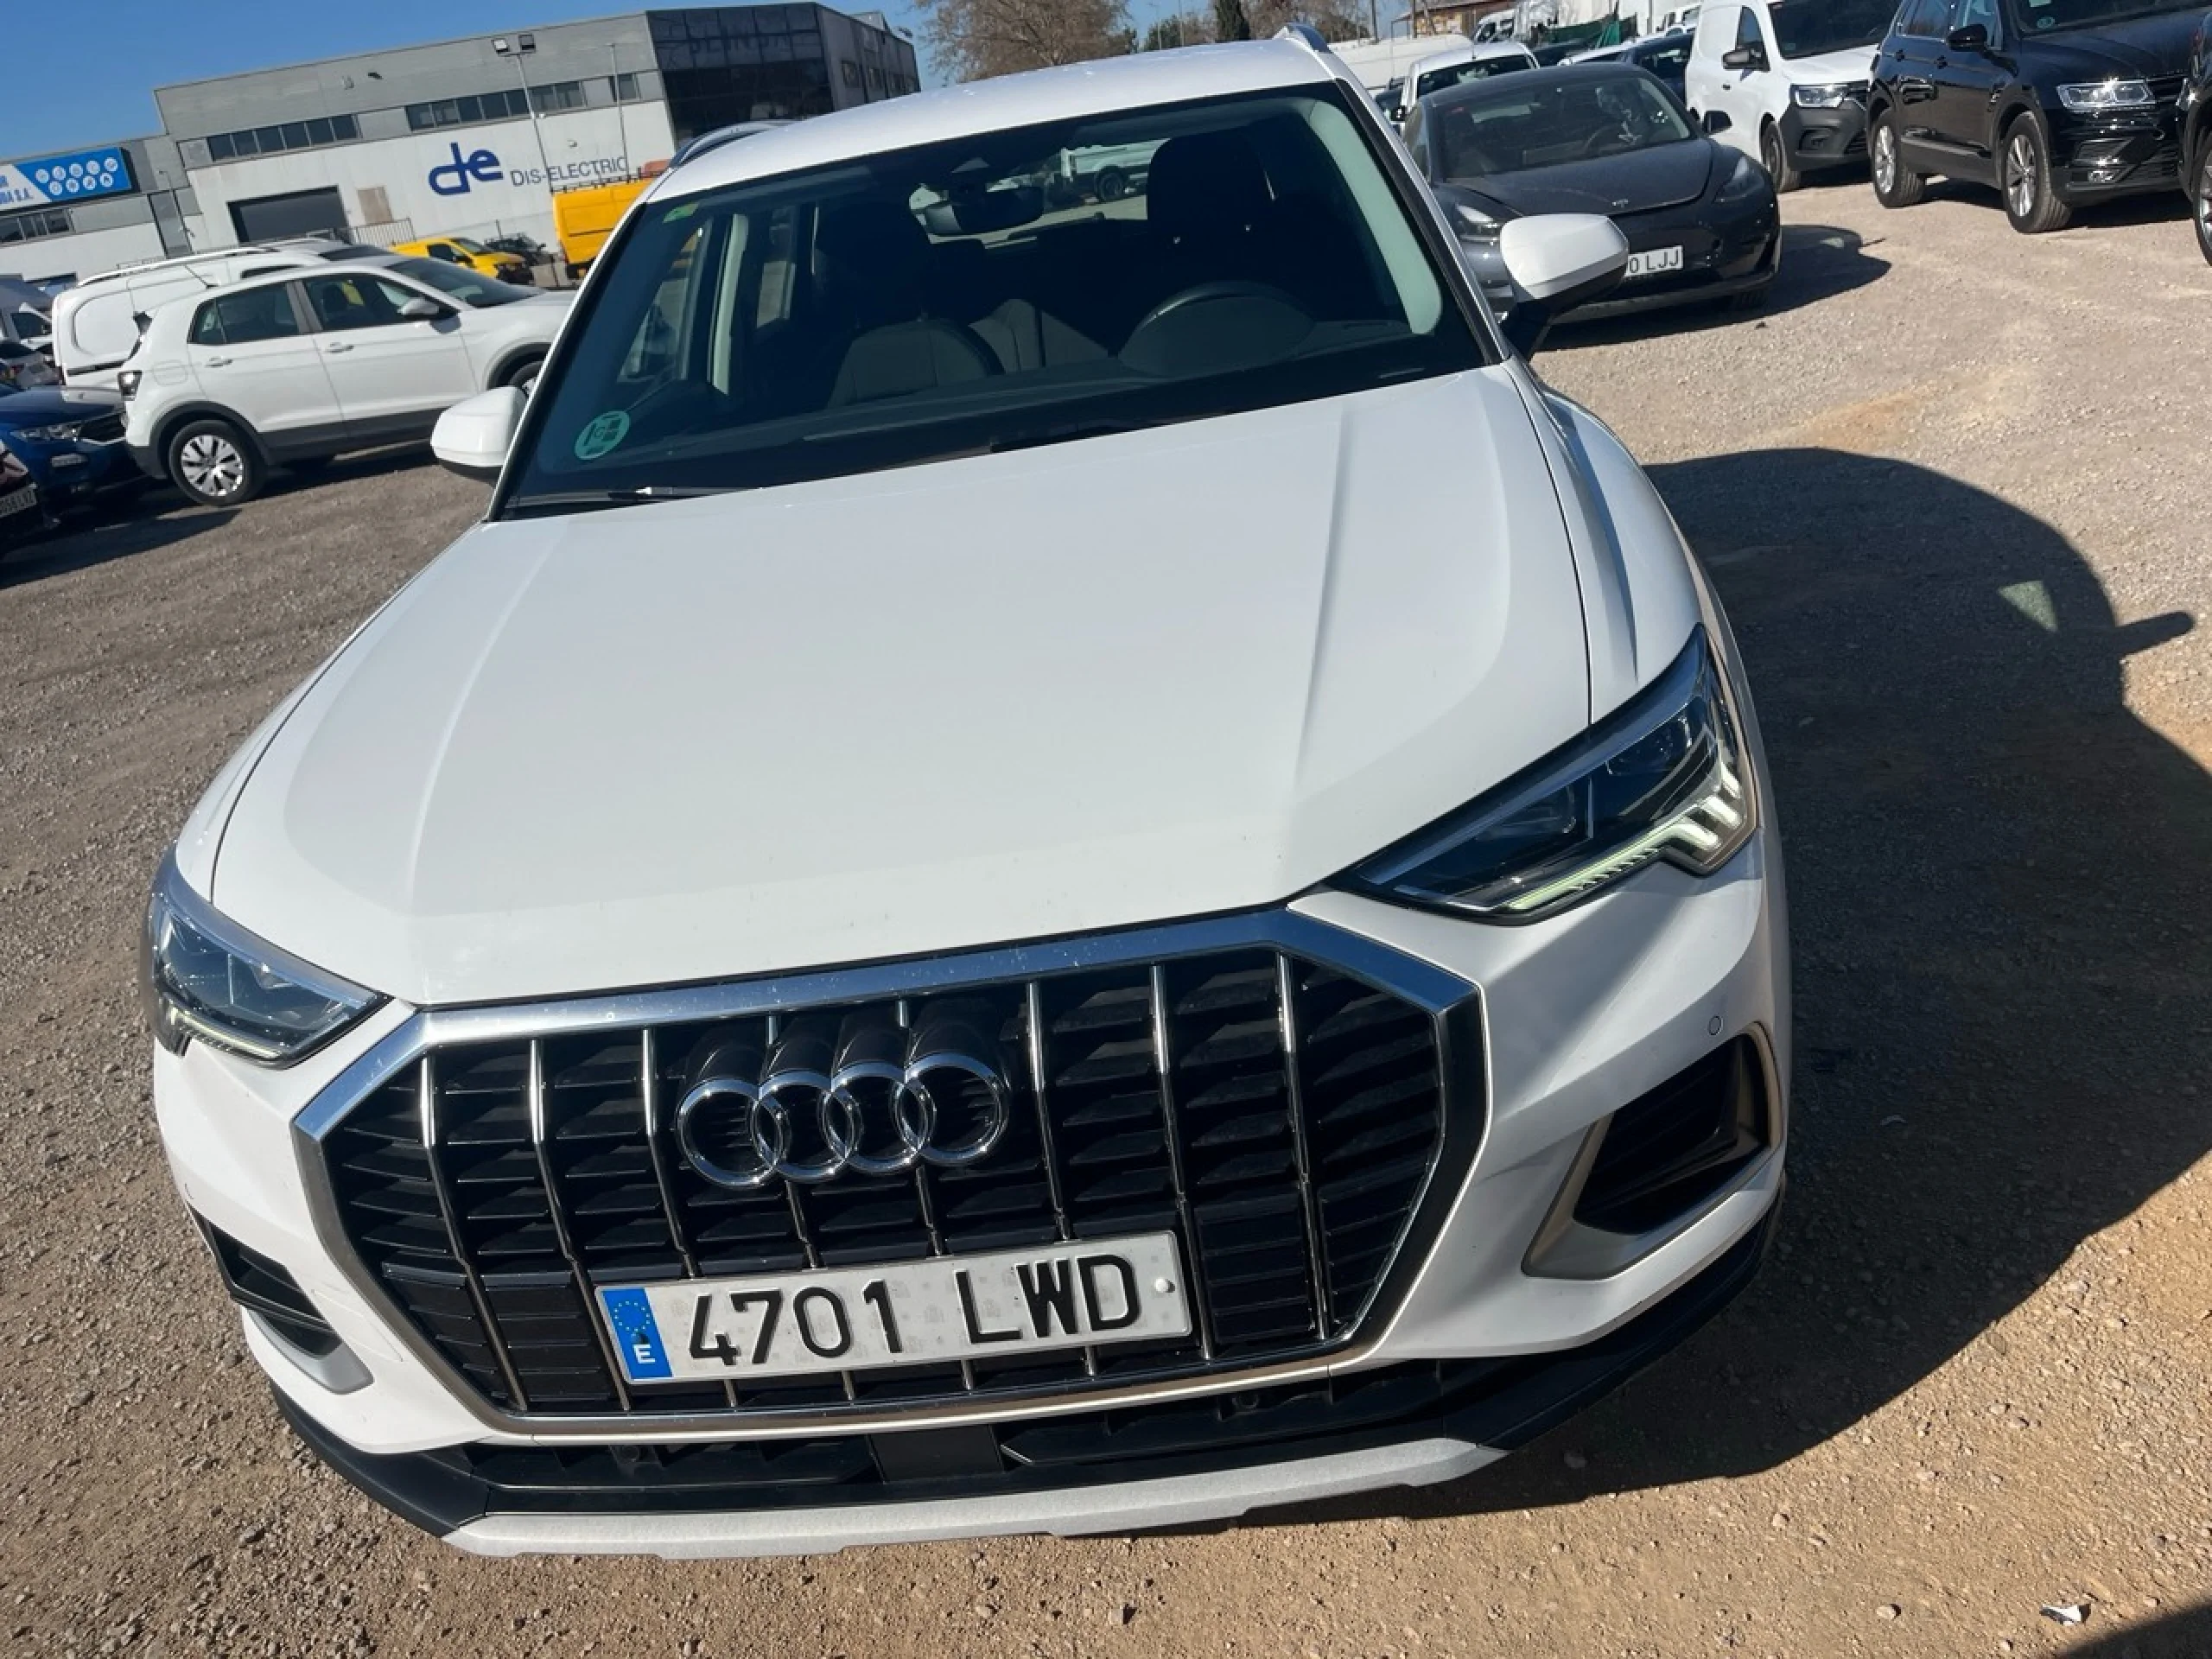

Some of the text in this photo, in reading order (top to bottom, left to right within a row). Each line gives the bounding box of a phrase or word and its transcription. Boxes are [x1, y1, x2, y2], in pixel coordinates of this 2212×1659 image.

[429, 142, 503, 195] de
[511, 156, 628, 187] DIS-ELECTRIC
[1646, 250, 1679, 270] LJJ
[688, 1254, 1141, 1366] 4701 LWD
[632, 1344, 656, 1364] E
